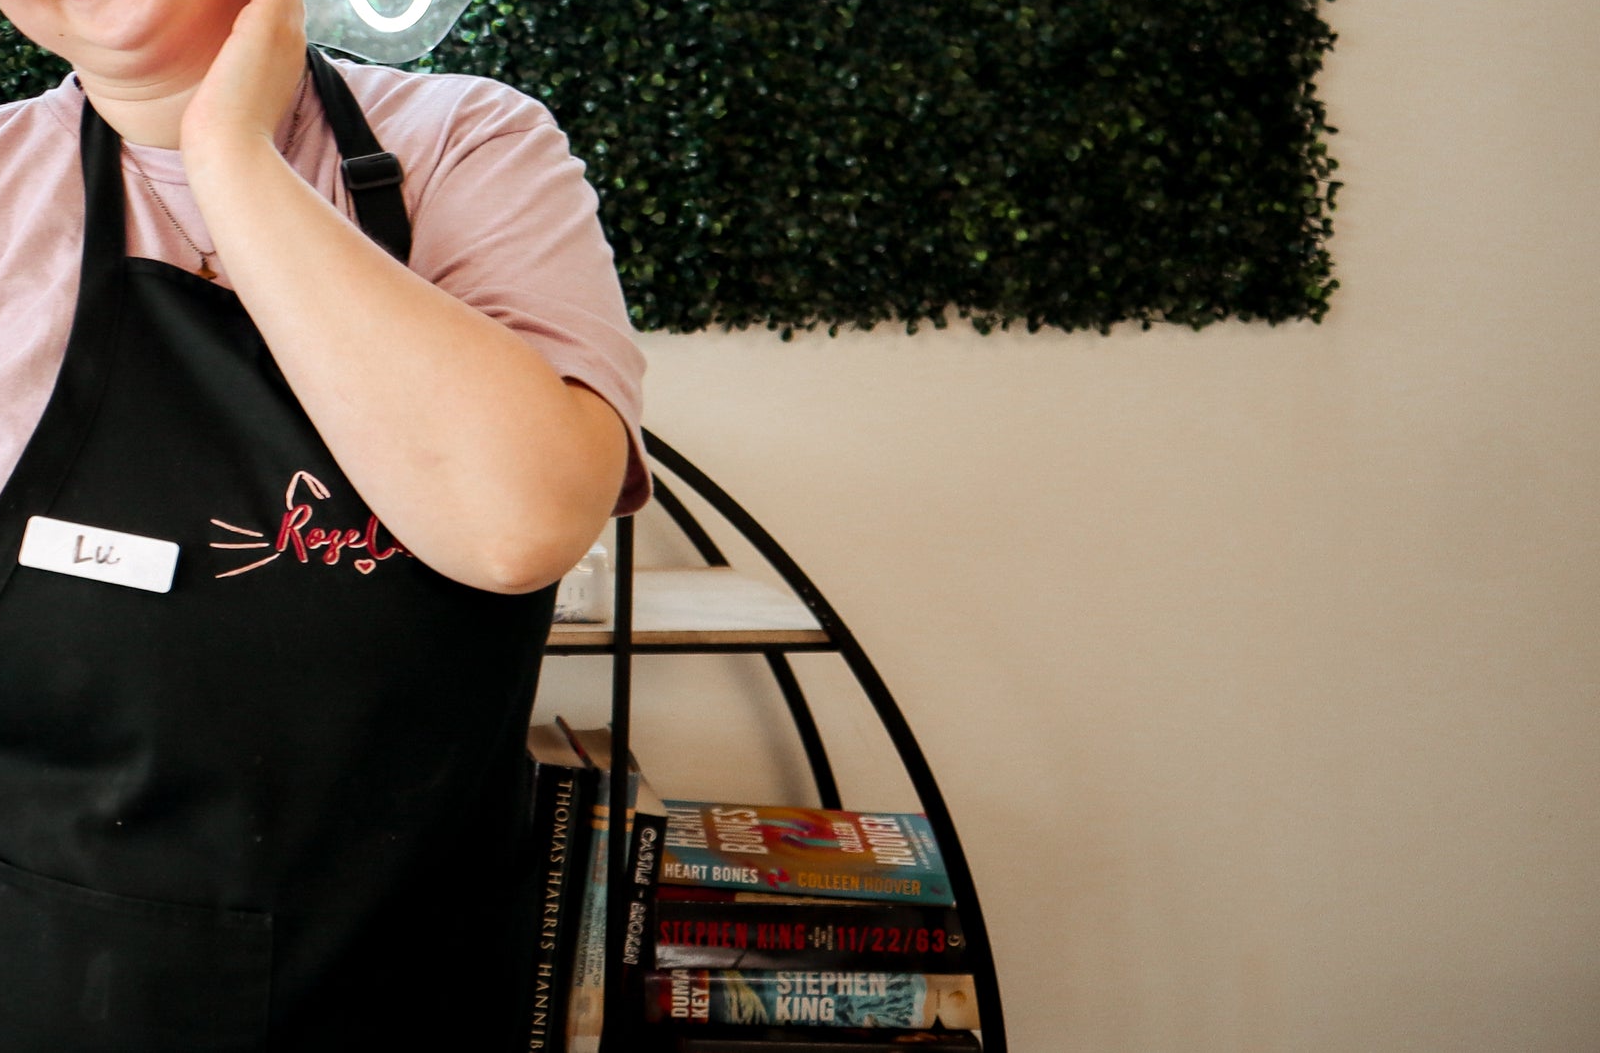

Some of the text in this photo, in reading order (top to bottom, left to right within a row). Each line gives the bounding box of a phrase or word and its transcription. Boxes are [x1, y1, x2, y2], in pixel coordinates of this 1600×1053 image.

[72, 534, 121, 567] Lu
[664, 806, 769, 855] HEART BONES
[857, 815, 918, 867] HOOVER
[663, 862, 921, 897] HEART BONES COLLEEN HOOVER
[527, 779, 573, 1053] THOMAS HARRIS HANNIB
[621, 900, 649, 966] BROKEN
[659, 919, 749, 949] STEPHEN
[755, 921, 807, 950] KING
[836, 925, 946, 954] 11/22/63
[671, 969, 689, 1019] DUMA
[690, 981, 710, 1019] KEY
[775, 970, 889, 997] STEPHEN
[775, 996, 836, 1021] KING
